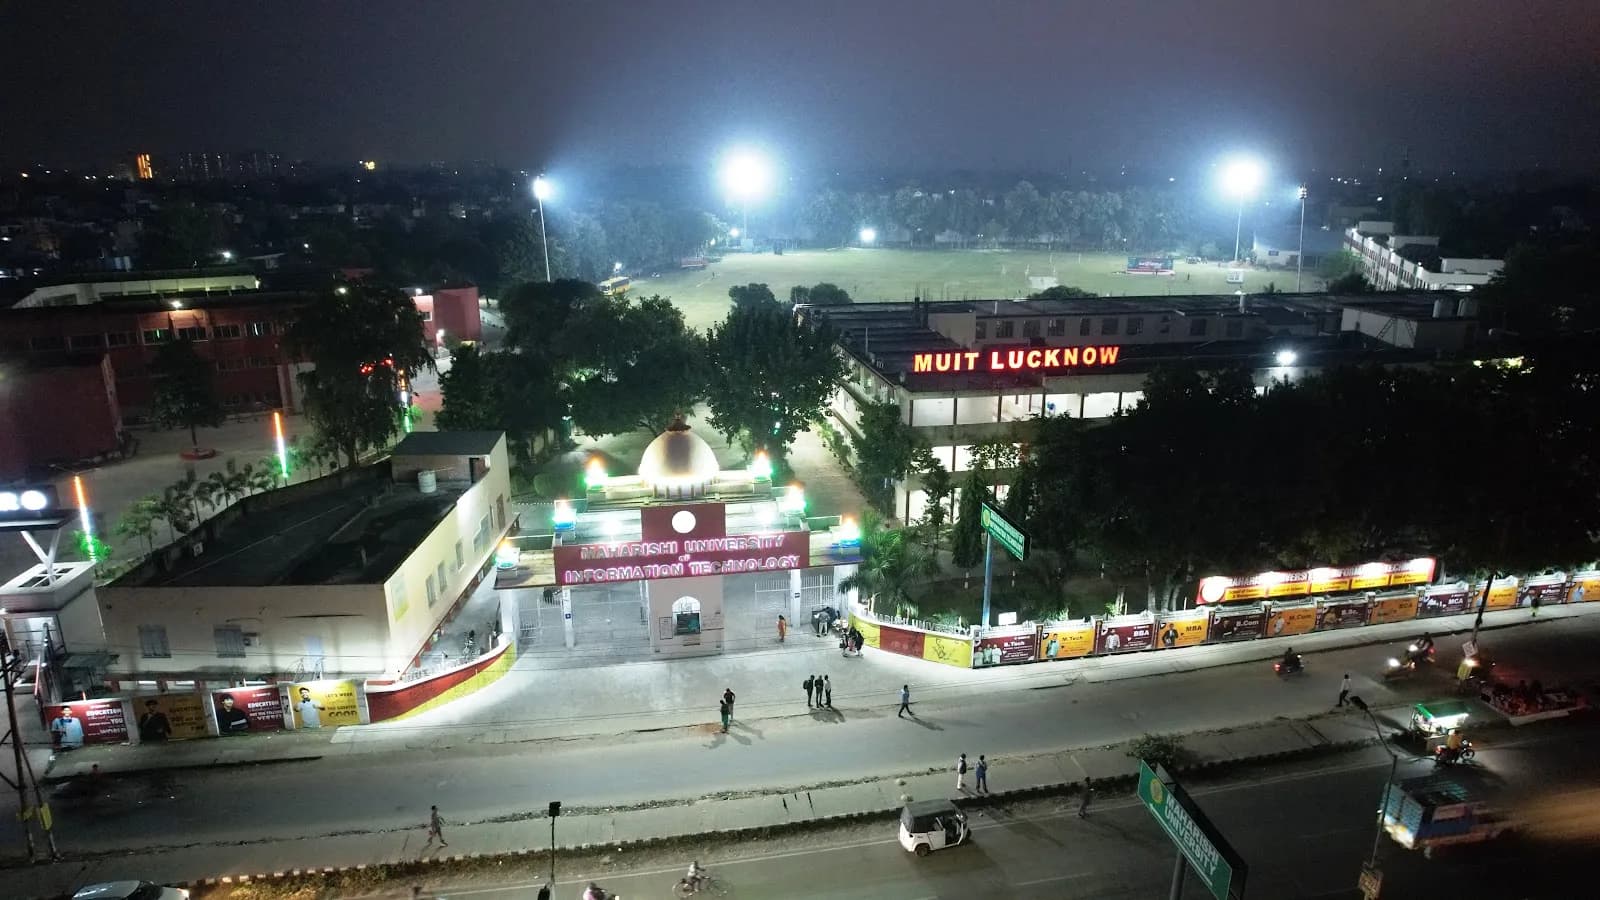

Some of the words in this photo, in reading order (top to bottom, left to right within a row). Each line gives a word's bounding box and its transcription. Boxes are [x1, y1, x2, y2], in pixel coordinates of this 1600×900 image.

[914, 352, 979, 372] MUIT
[991, 346, 1119, 370] LUCKNOW
[581, 541, 677, 560] MAHARISHI
[684, 535, 784, 553] UNIVERSITY
[565, 563, 683, 583] INFORMATION
[690, 555, 800, 575] TECHNOLOGY
[328, 710, 357, 718] GOOD
[1164, 805, 1216, 876] UNIVERSITY
[1167, 793, 1219, 866] MAHARISHI
